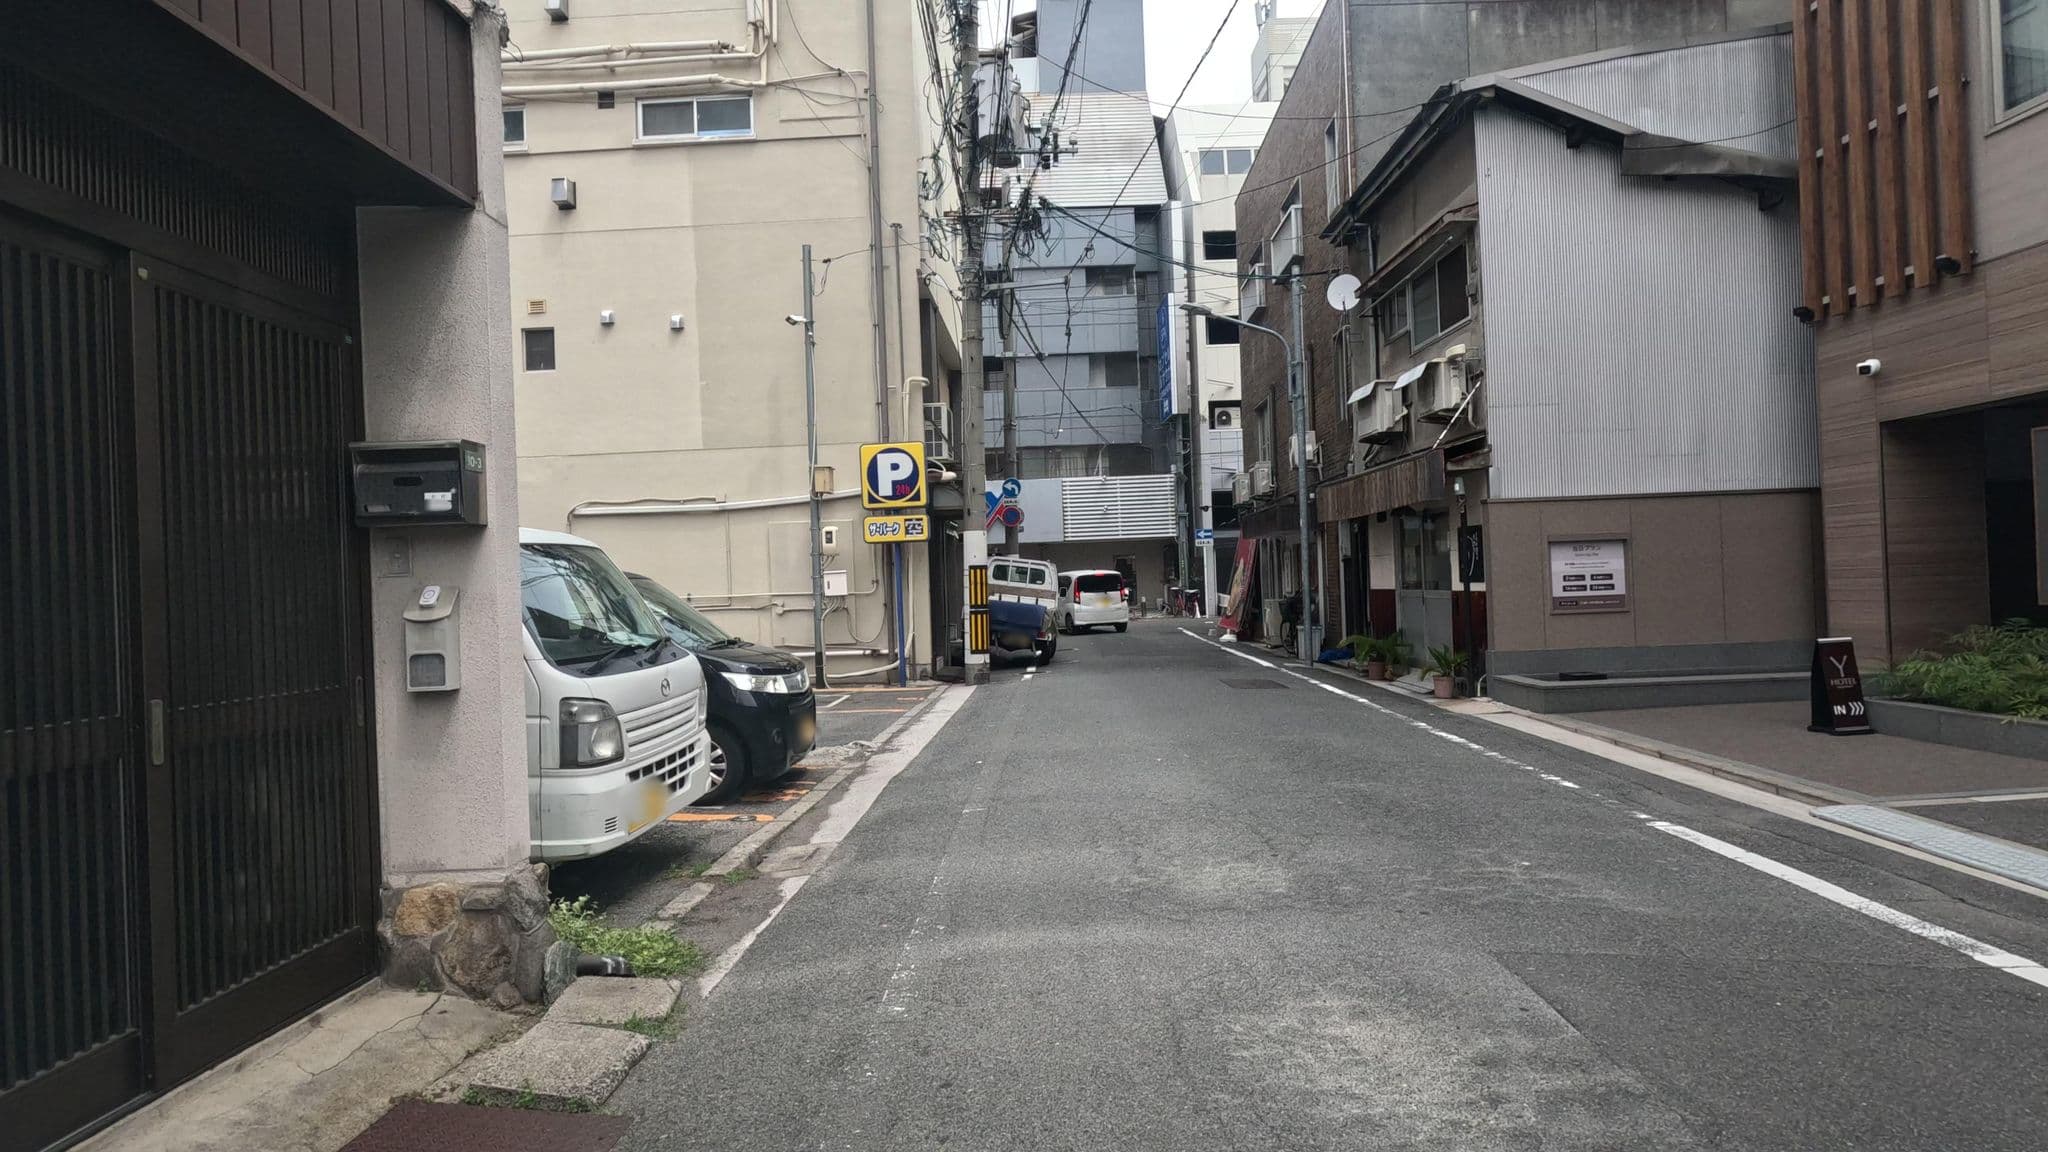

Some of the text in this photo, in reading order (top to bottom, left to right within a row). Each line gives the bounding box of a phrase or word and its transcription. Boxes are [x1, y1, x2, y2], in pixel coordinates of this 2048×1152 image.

[1829, 655, 1848, 678] Y
[1830, 678, 1857, 686] HOTEL
[1833, 704, 1847, 716] IN
